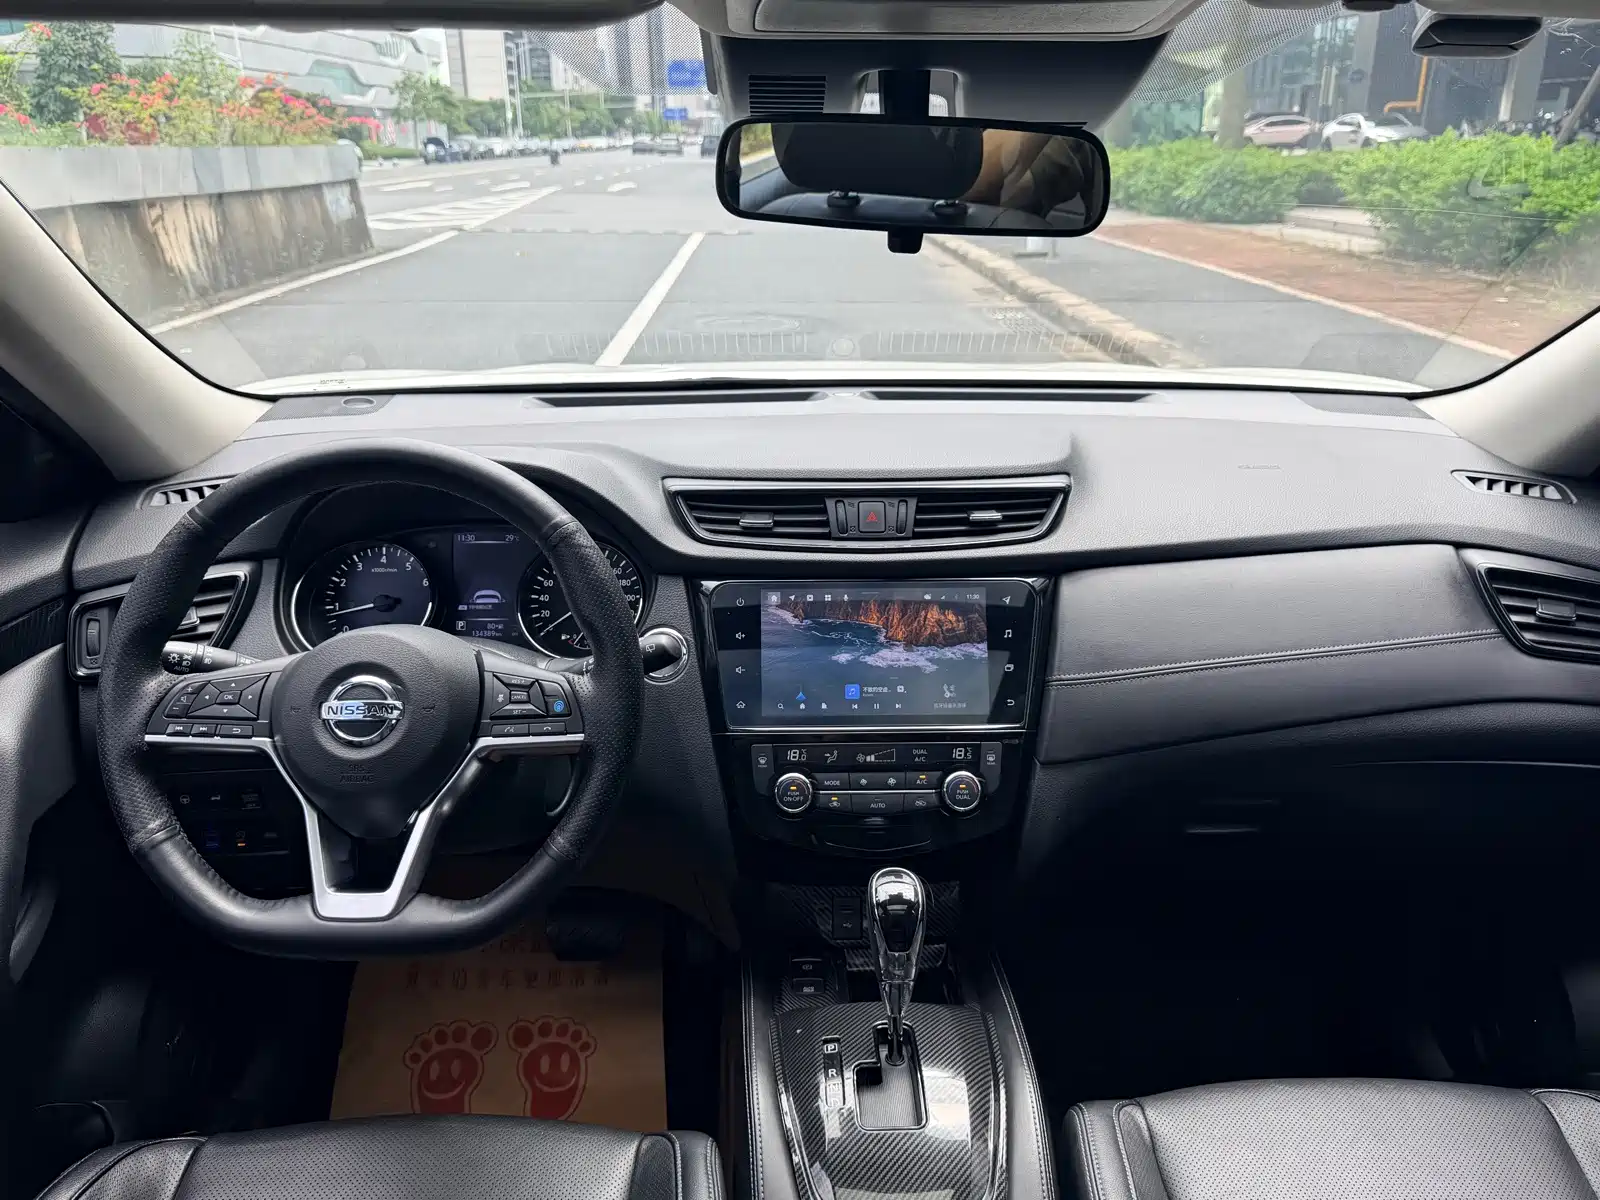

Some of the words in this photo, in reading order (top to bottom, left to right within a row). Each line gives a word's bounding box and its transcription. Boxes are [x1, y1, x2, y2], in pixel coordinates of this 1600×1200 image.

[380, 556, 387, 564] 4
[357, 563, 363, 571] 3
[405, 563, 412, 571] 5
[340, 579, 347, 587] 2
[422, 578, 429, 586] 6
[543, 579, 554, 587] 60
[333, 602, 339, 610] 1
[327, 704, 394, 717] NISSAN
[828, 1068, 837, 1077] R
